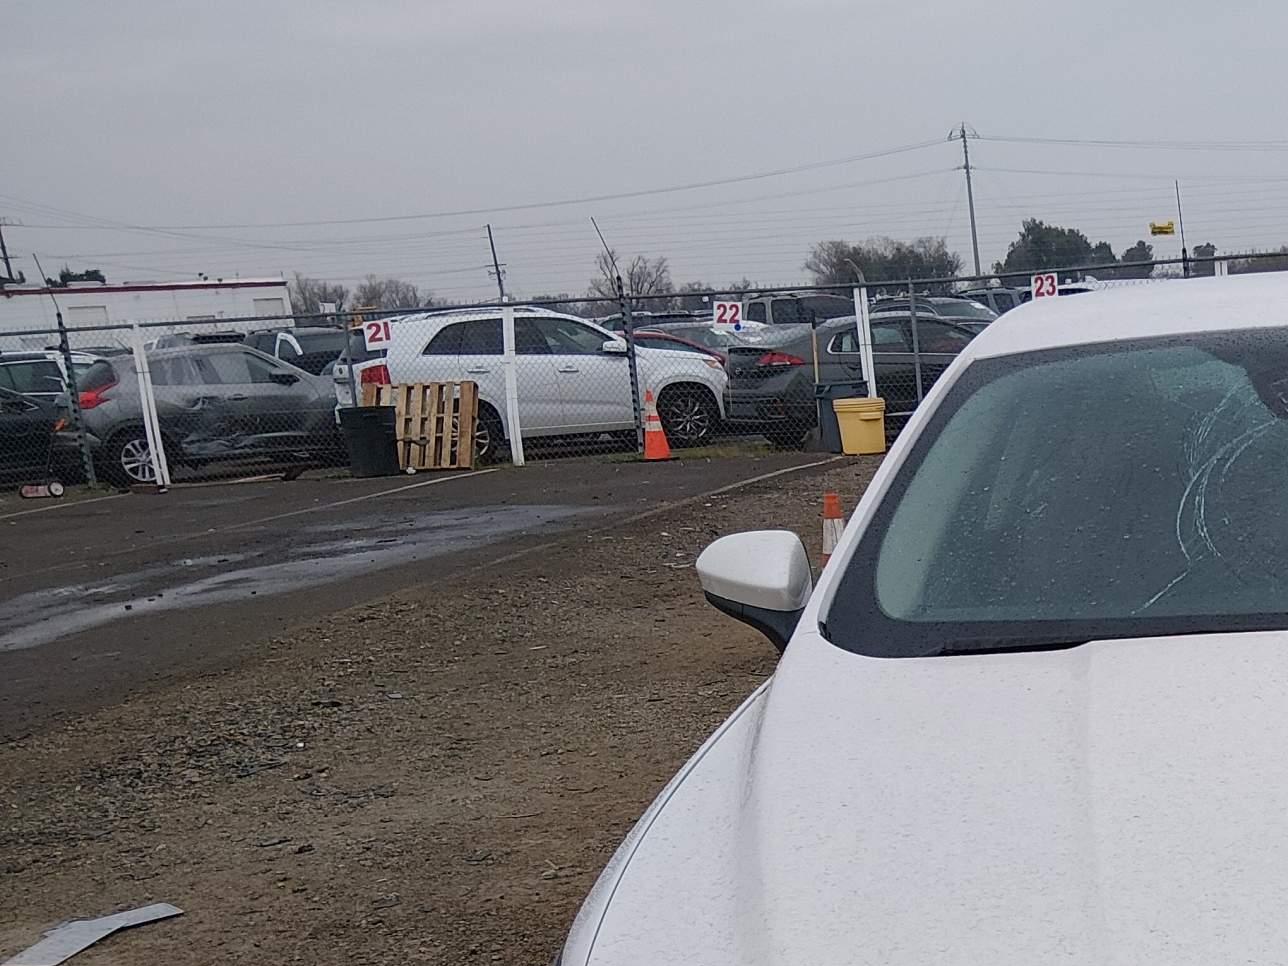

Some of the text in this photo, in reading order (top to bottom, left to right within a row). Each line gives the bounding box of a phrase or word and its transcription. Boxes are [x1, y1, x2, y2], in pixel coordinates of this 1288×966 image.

[1034, 273, 1057, 297] 23
[716, 304, 741, 324] 22
[366, 321, 392, 343] 21
